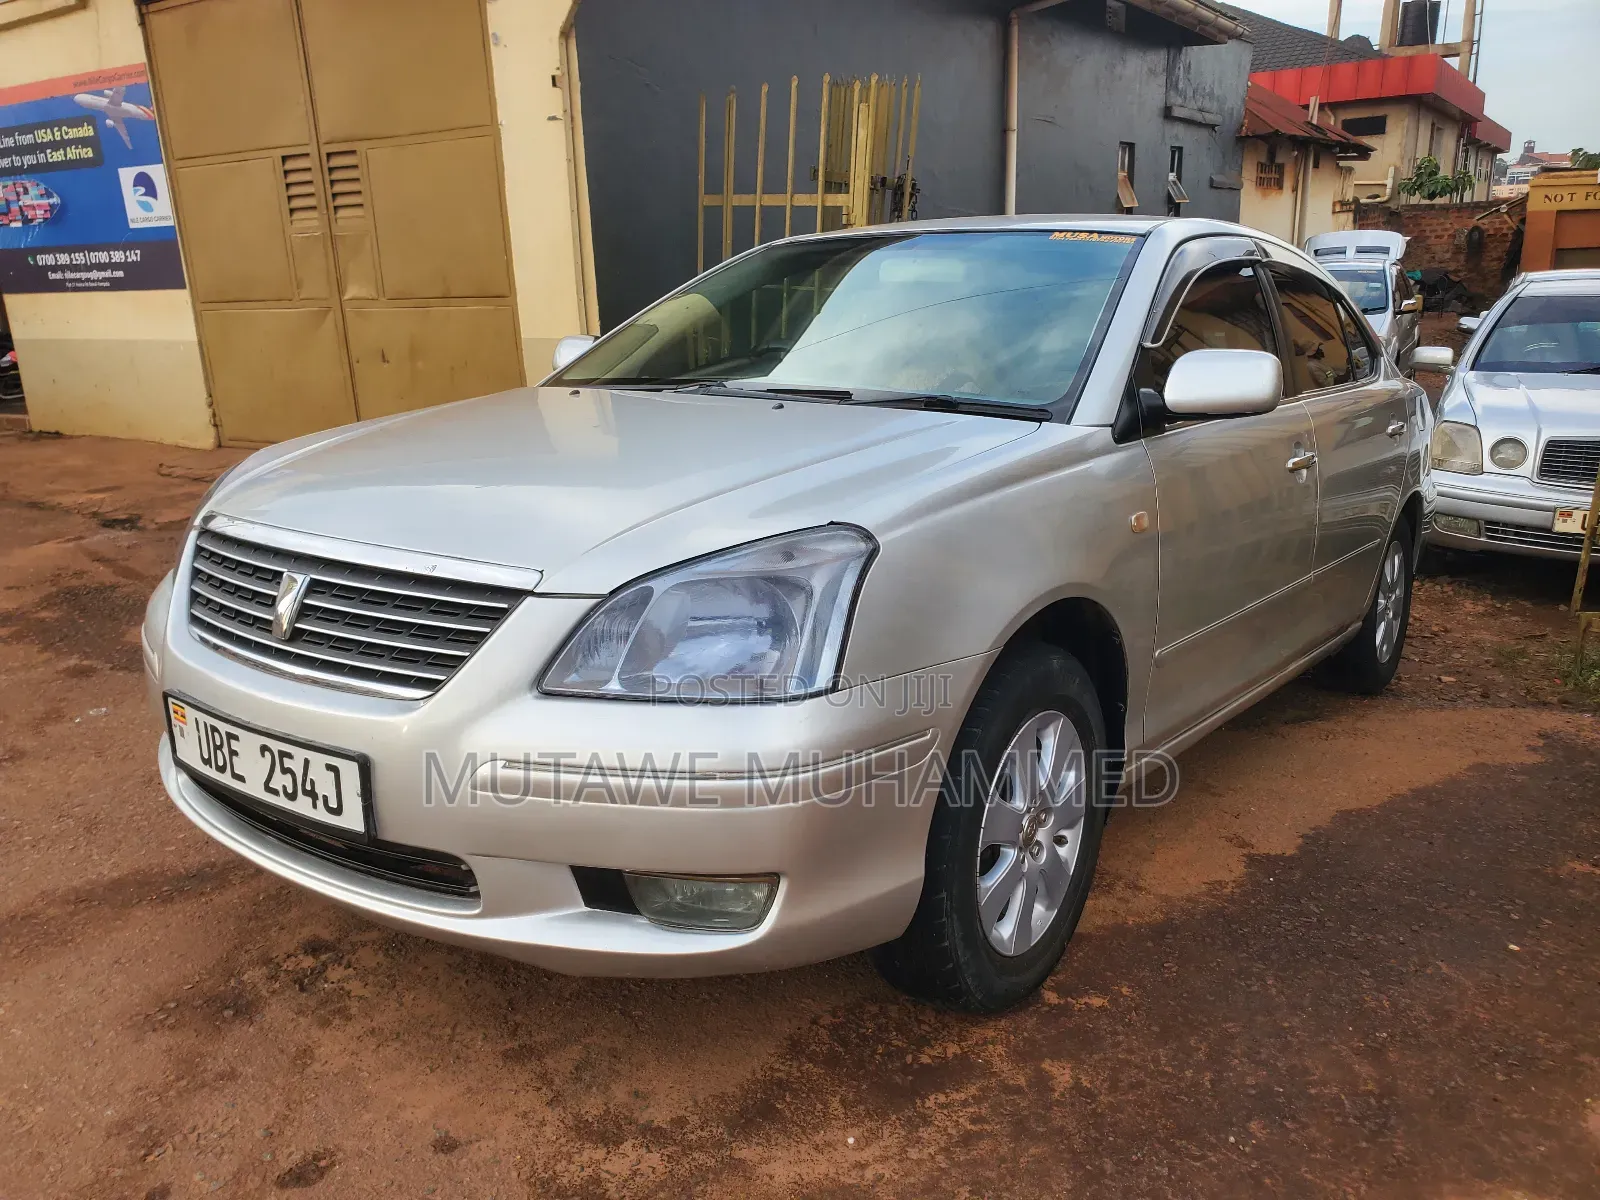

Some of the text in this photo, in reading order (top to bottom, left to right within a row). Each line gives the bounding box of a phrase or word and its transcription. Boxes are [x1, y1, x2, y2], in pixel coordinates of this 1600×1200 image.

[15, 132, 35, 146] from
[35, 128, 53, 143] USA
[54, 127, 61, 140] &
[62, 122, 95, 139] Canada
[12, 155, 21, 167] to
[22, 153, 37, 169] you
[37, 151, 46, 163] in
[46, 148, 65, 163] East
[67, 145, 94, 161] Africa
[1543, 192, 1577, 204] NOT
[1050, 231, 1099, 239] MUSA
[36, 254, 55, 266] 0700
[55, 253, 70, 265] 389
[71, 252, 85, 265] 155
[90, 251, 110, 264] 0700
[110, 250, 125, 263] 389
[126, 249, 141, 262] 147
[194, 717, 344, 817] UBE 254J
